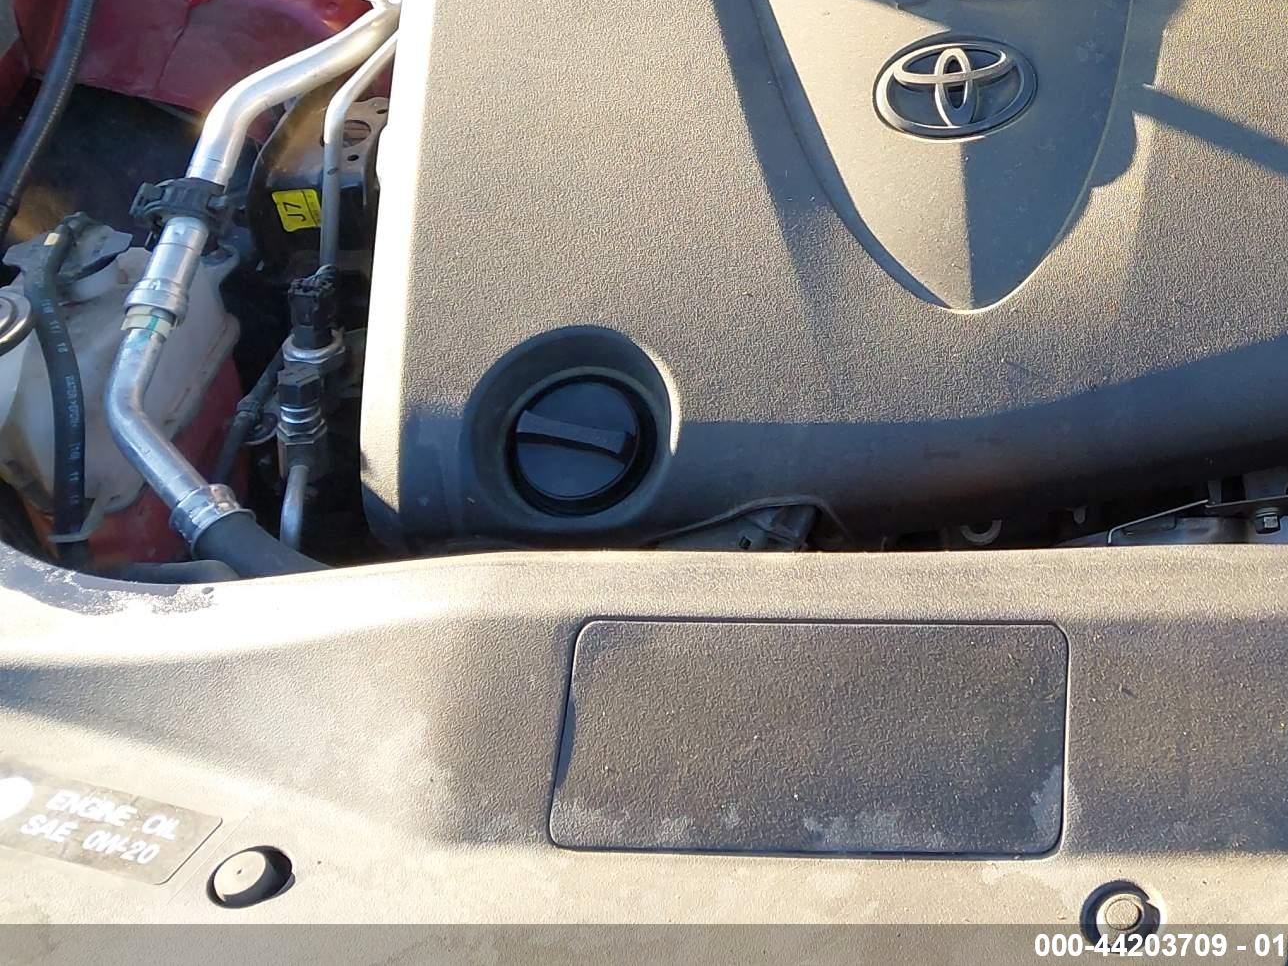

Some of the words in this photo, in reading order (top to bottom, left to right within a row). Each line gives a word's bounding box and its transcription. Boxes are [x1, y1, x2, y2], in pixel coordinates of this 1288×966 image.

[20, 815, 78, 842] SAE
[82, 831, 161, 864] 0W-20
[46, 790, 138, 827] ENGINE
[143, 814, 180, 840] OIL
